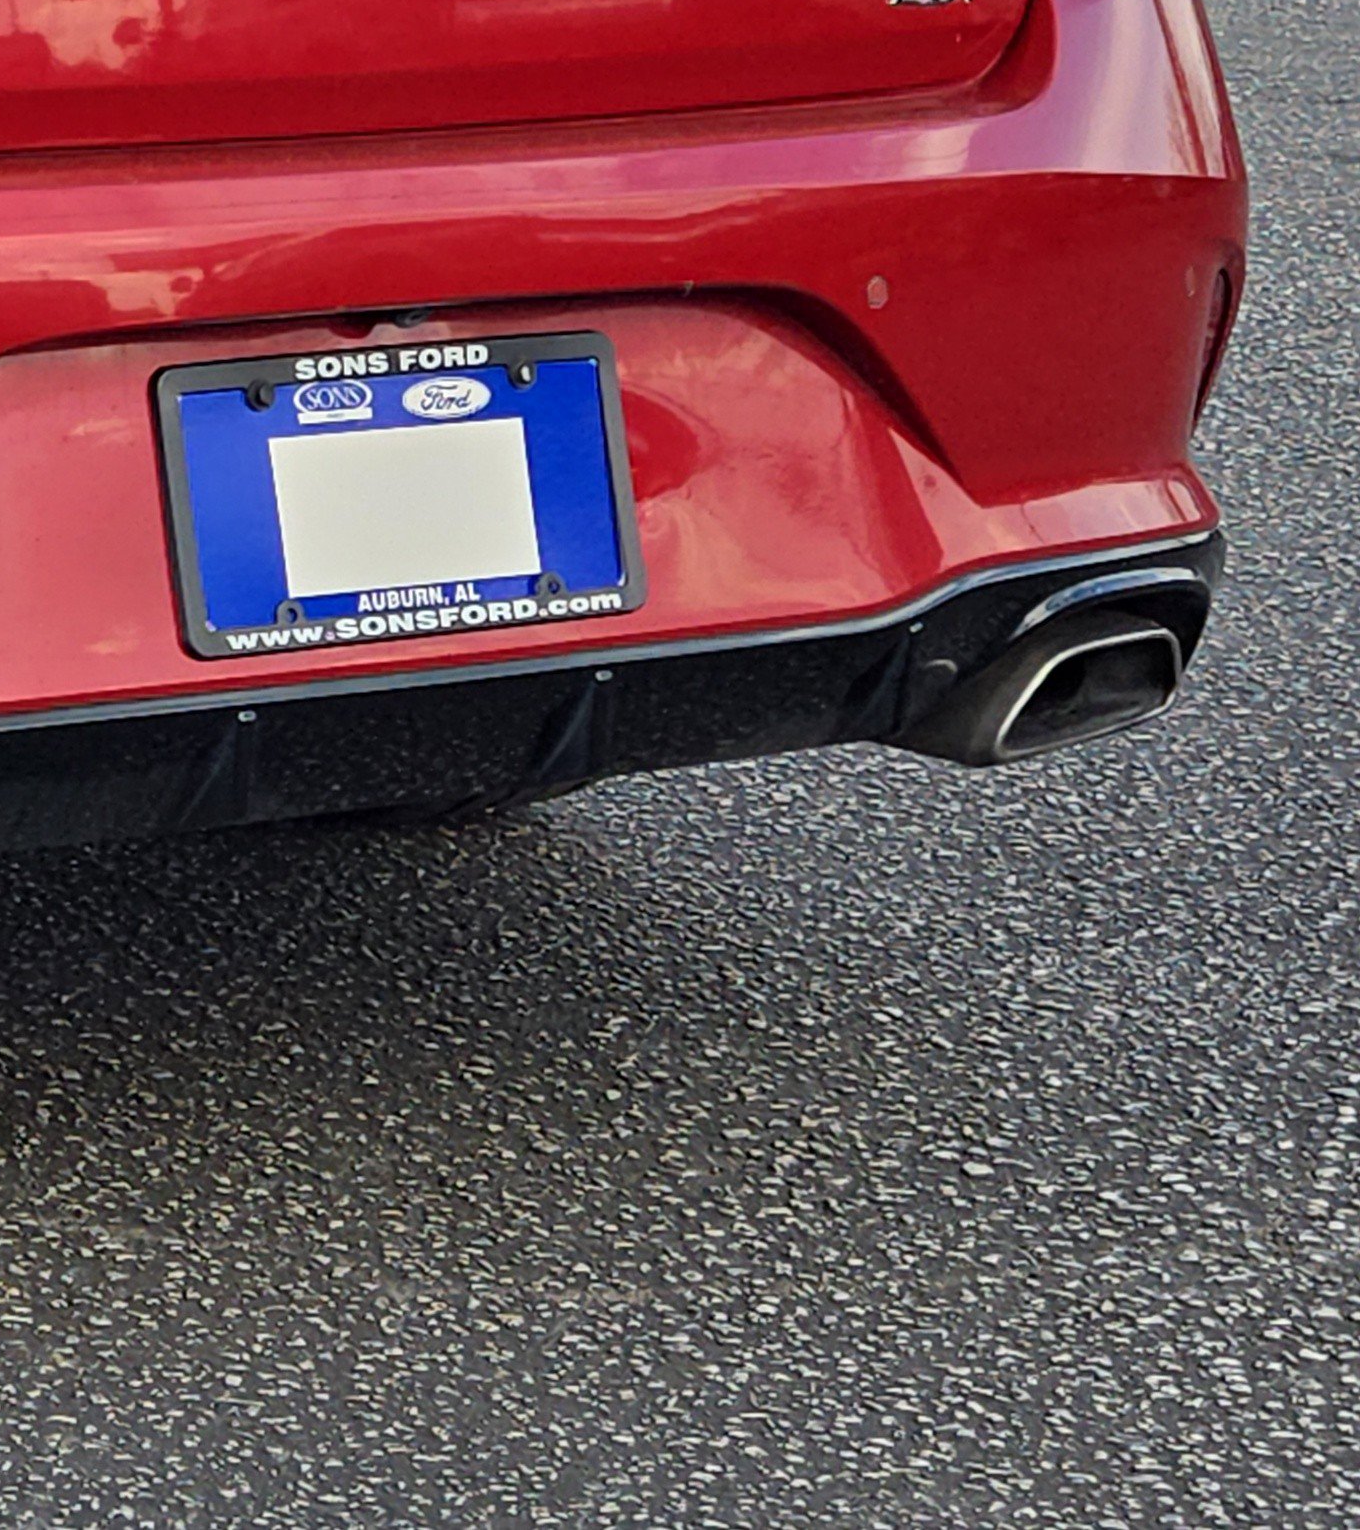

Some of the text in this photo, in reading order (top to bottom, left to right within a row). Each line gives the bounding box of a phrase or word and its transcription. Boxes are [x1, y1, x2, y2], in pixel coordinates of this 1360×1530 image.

[295, 344, 489, 381] SONS FORD
[305, 383, 362, 410] SONS
[421, 384, 472, 411] Ford
[357, 581, 481, 613] AUBURN, AL
[226, 592, 623, 651] www.SONSFORD.com
